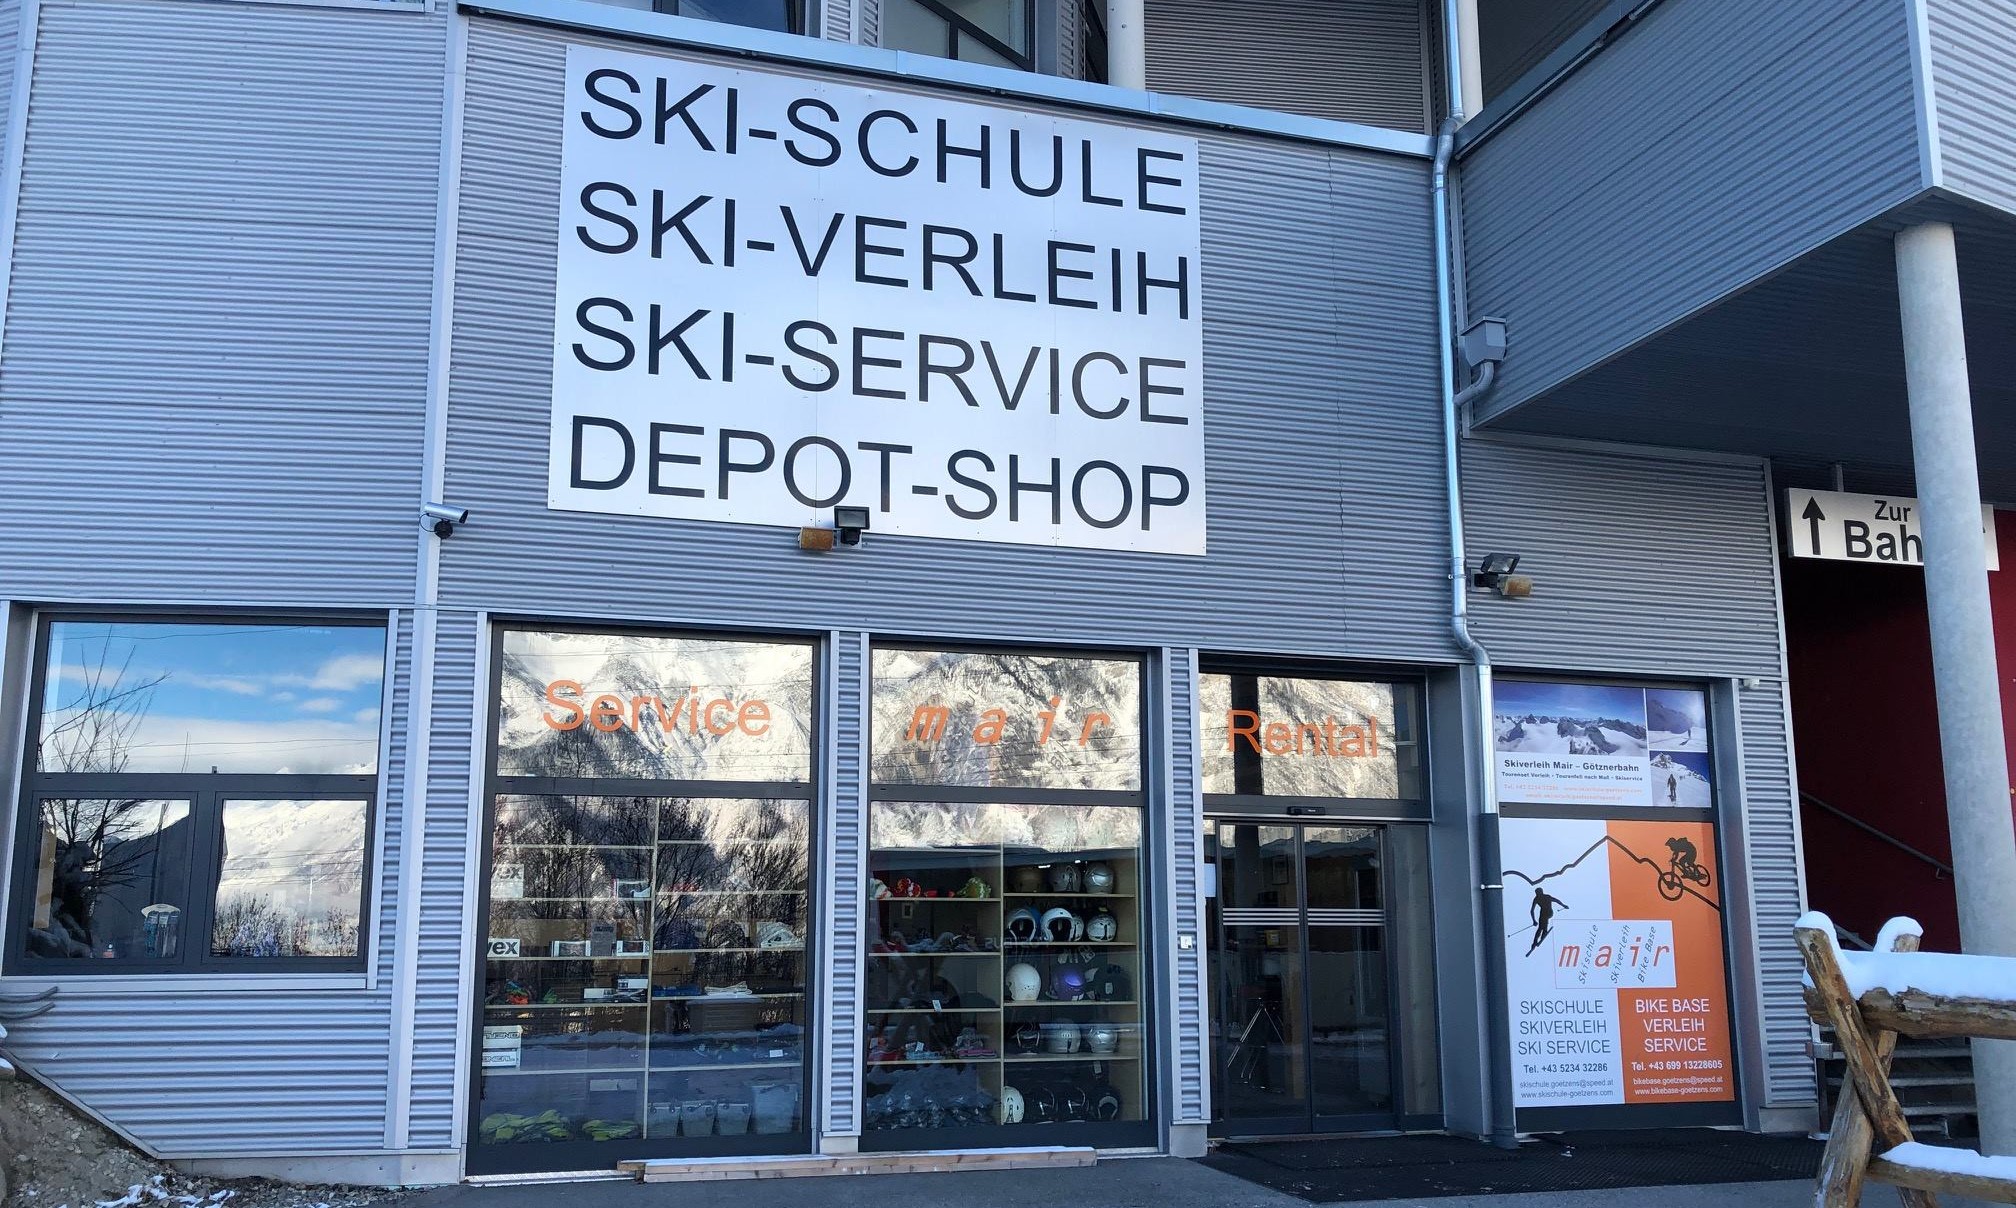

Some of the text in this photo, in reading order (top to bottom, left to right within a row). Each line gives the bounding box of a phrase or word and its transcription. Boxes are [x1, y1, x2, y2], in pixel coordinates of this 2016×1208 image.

[581, 68, 1187, 215] SKI-SCHULE
[576, 182, 1190, 320] SKI-VERLEIH
[572, 296, 1190, 426] SKI-SERVICE
[570, 415, 1191, 532] DEPOT-SHOP
[1874, 499, 1911, 522] Zur
[1844, 519, 1924, 563] Bah
[543, 679, 771, 736] Service
[905, 695, 1111, 747] mair
[1227, 709, 1378, 758] Rental
[1504, 759, 1551, 769] Skiverleih
[1553, 761, 1574, 769] Mair
[1582, 762, 1640, 772] Götznerbahn
[1558, 936, 1670, 968] mair
[1578, 924, 1599, 985] Skischule
[1610, 924, 1631, 984] Skiverleih
[1637, 926, 1657, 983] Bike Base
[1520, 1000, 1604, 1014] SKISCHULE
[1635, 998, 1711, 1013] BIKE BASE
[1519, 1020, 1607, 1034] SKIVERLEIH
[1643, 1018, 1705, 1032] VERLEIH
[1518, 1040, 1612, 1055] SKI SERVICE
[1644, 1038, 1708, 1052] SERVICE
[1523, 1062, 1608, 1074] Tel. +43 5234 32286
[1631, 1060, 1723, 1071] Tel. +43 699 13228605
[1519, 1079, 1614, 1089] skischule.goetzens@speed.at
[1520, 1089, 1614, 1099] www.skischule-goetzens.com
[1634, 1086, 1724, 1096] www.bikebase-goetzens.com
